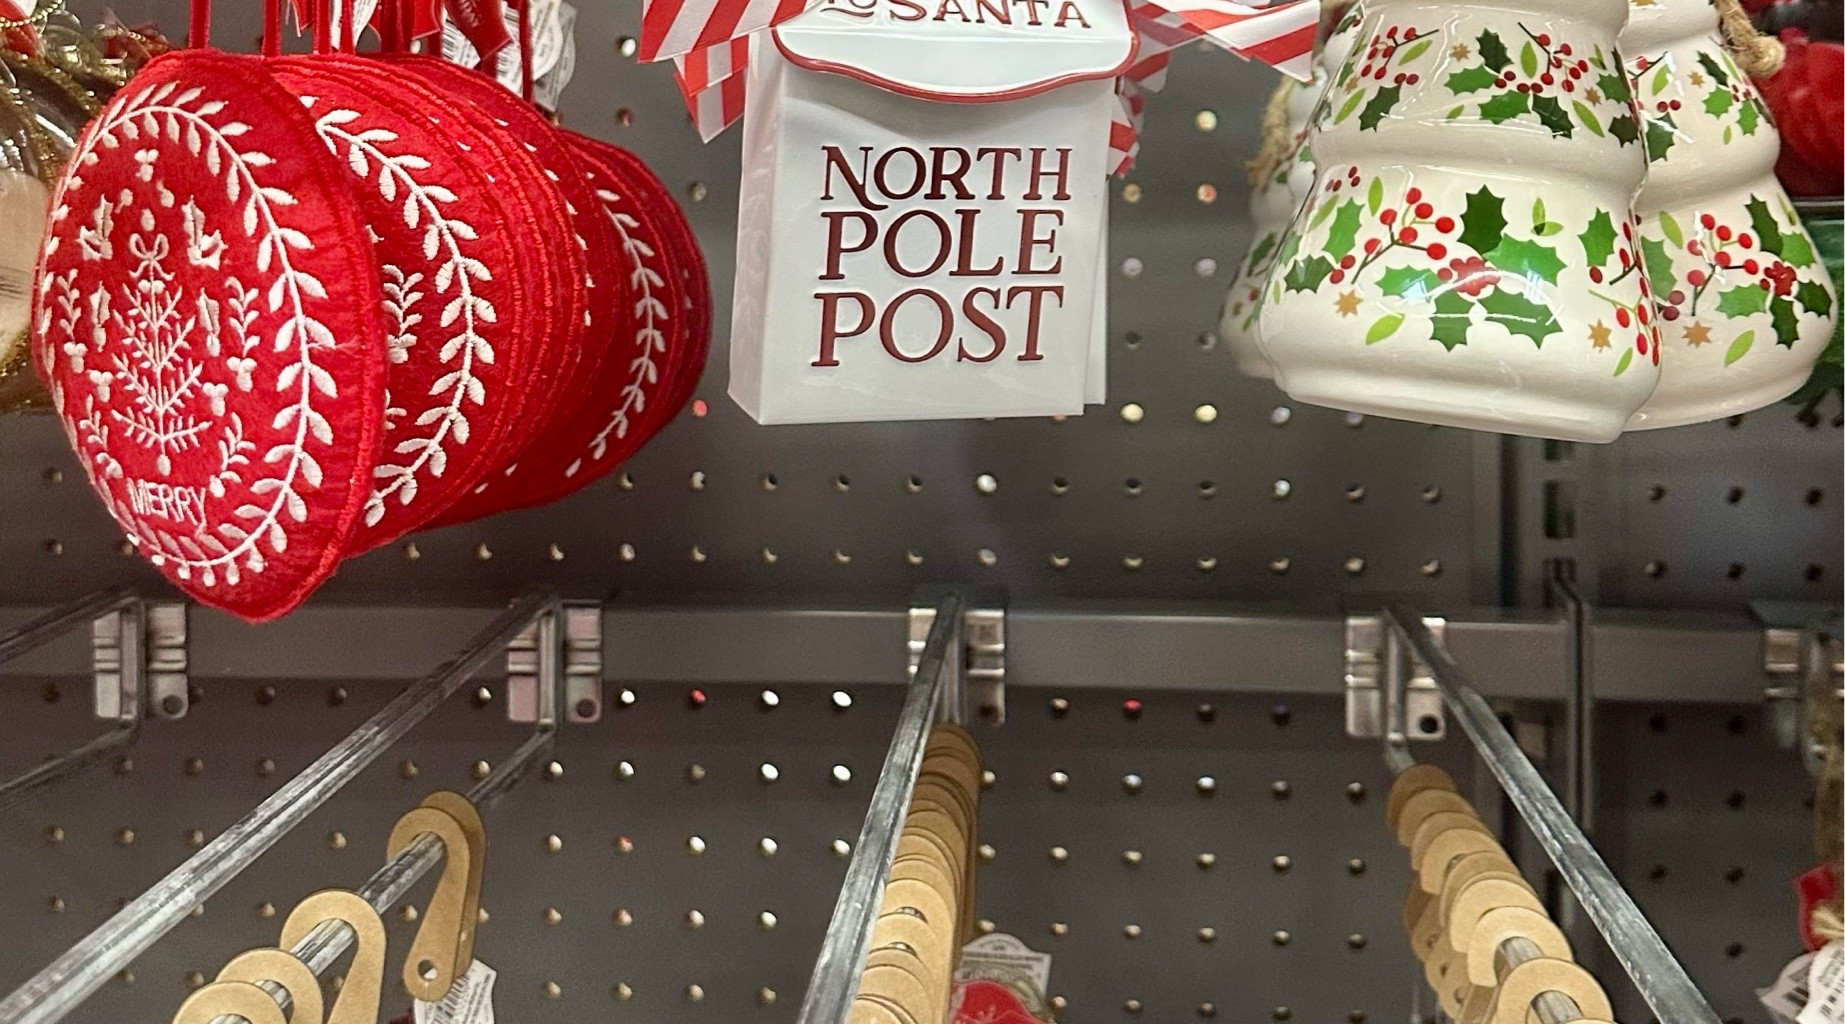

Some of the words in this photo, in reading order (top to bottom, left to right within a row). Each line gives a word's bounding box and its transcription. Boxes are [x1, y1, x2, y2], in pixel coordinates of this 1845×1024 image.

[820, 145, 1073, 211] NORTH
[819, 208, 1064, 280] POLE
[811, 286, 1064, 367] POST
[126, 477, 207, 538] MERRY
